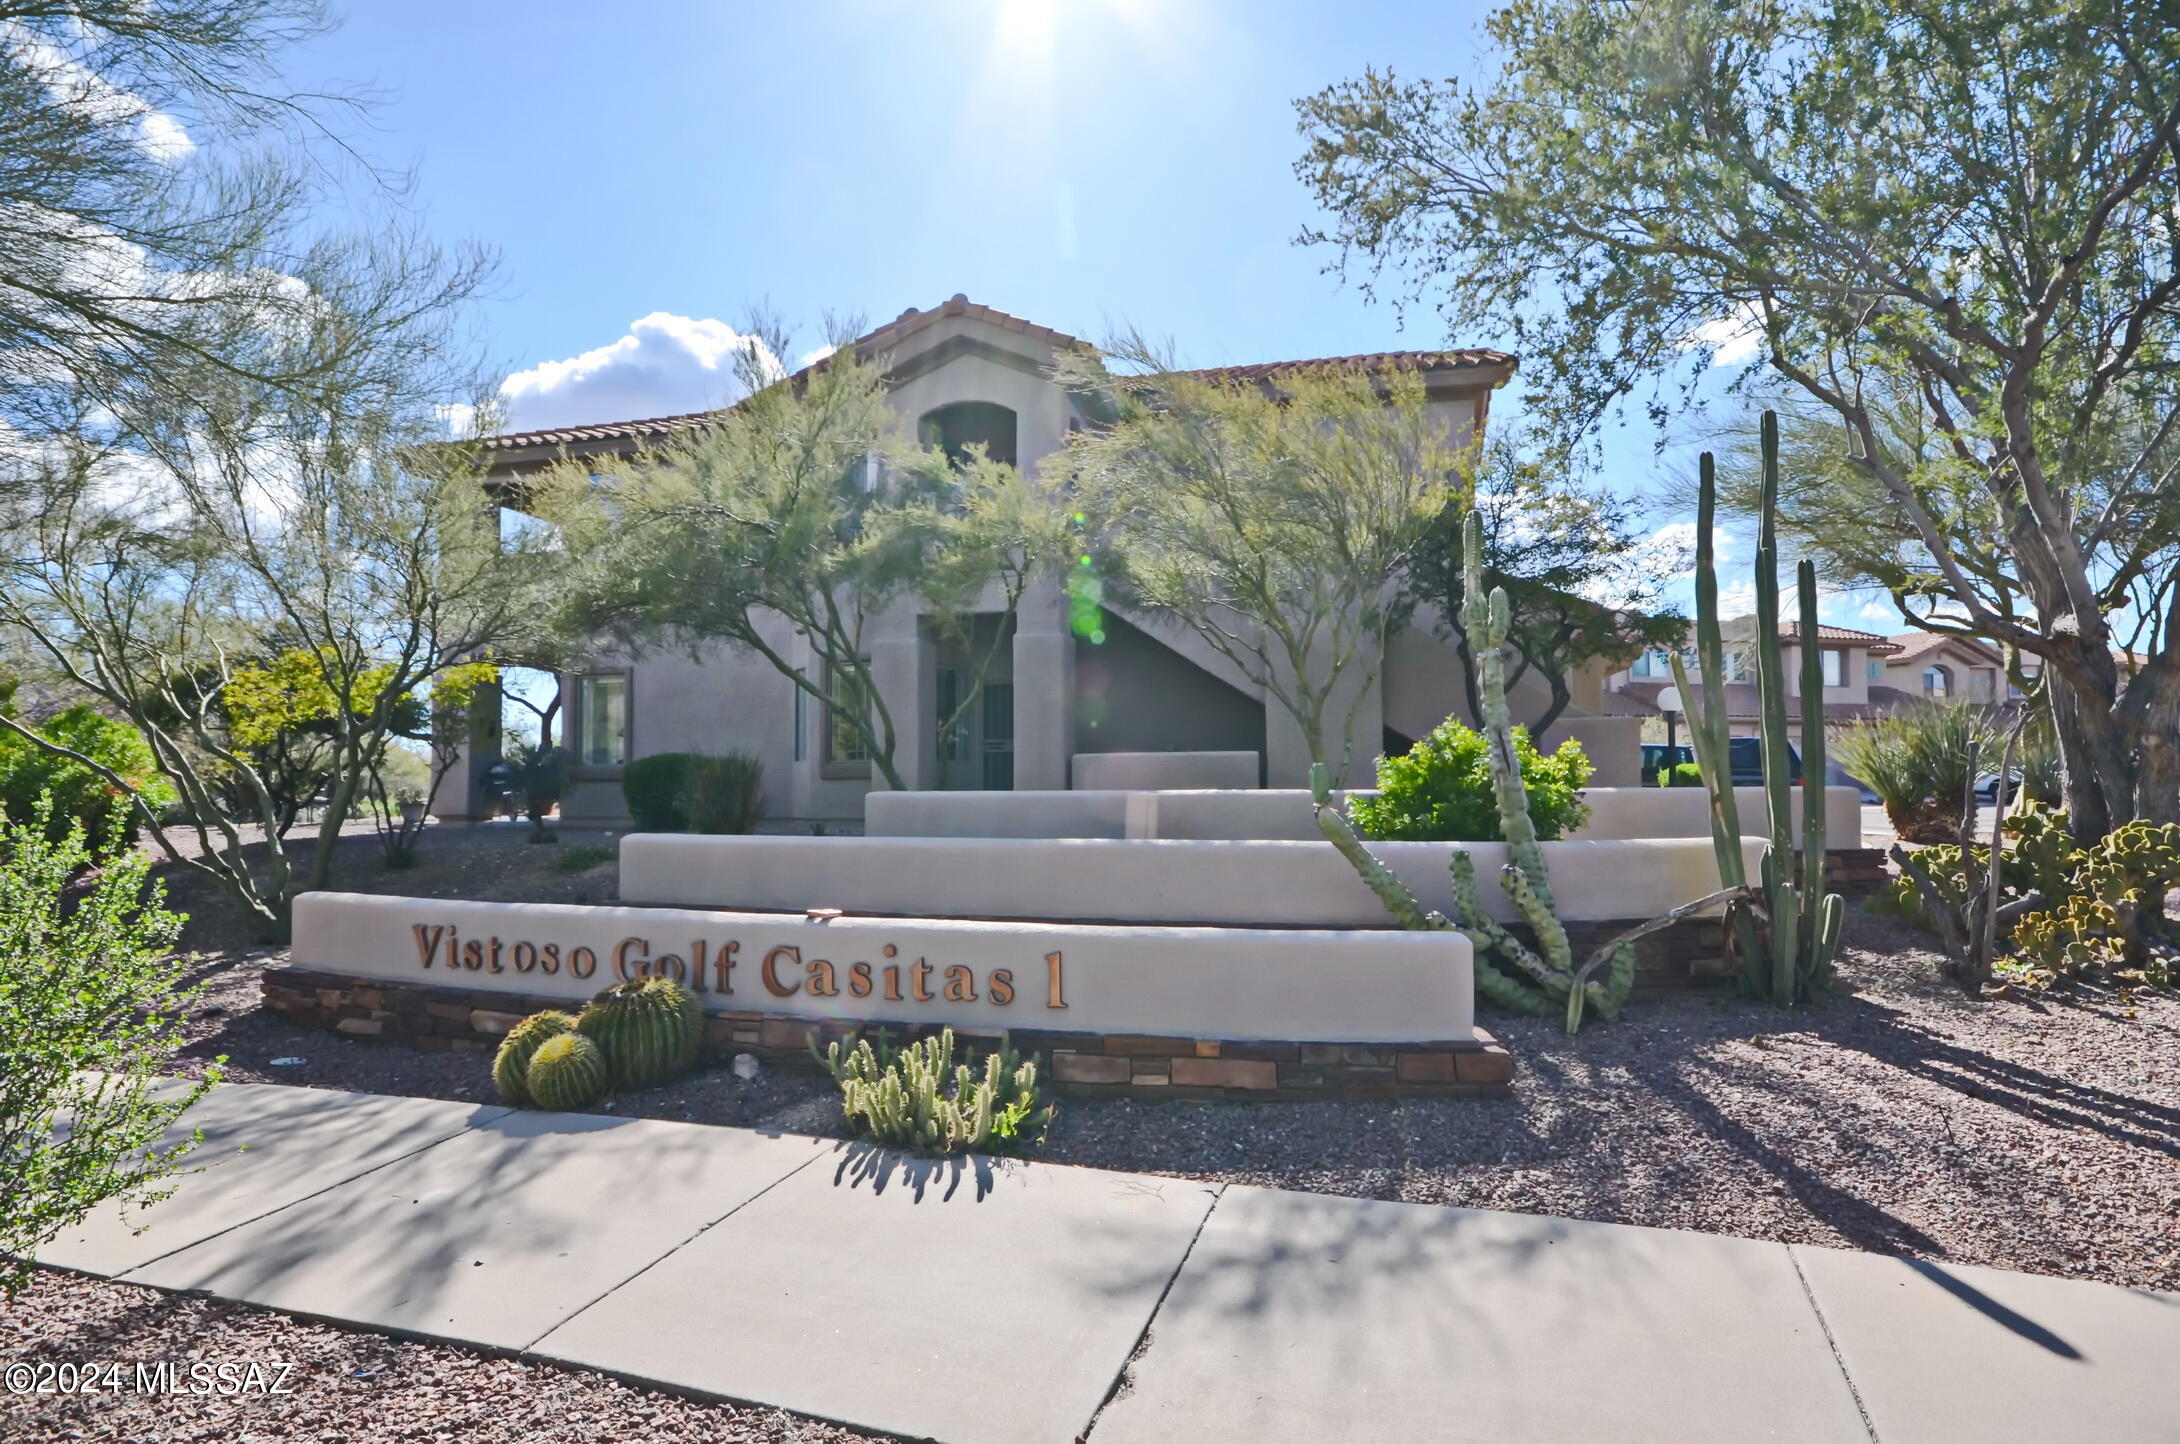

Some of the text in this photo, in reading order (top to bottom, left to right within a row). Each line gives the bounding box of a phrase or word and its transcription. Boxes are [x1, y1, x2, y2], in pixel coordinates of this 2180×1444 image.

[413, 924, 1069, 1008] Vistoso Golf Casitas 1
